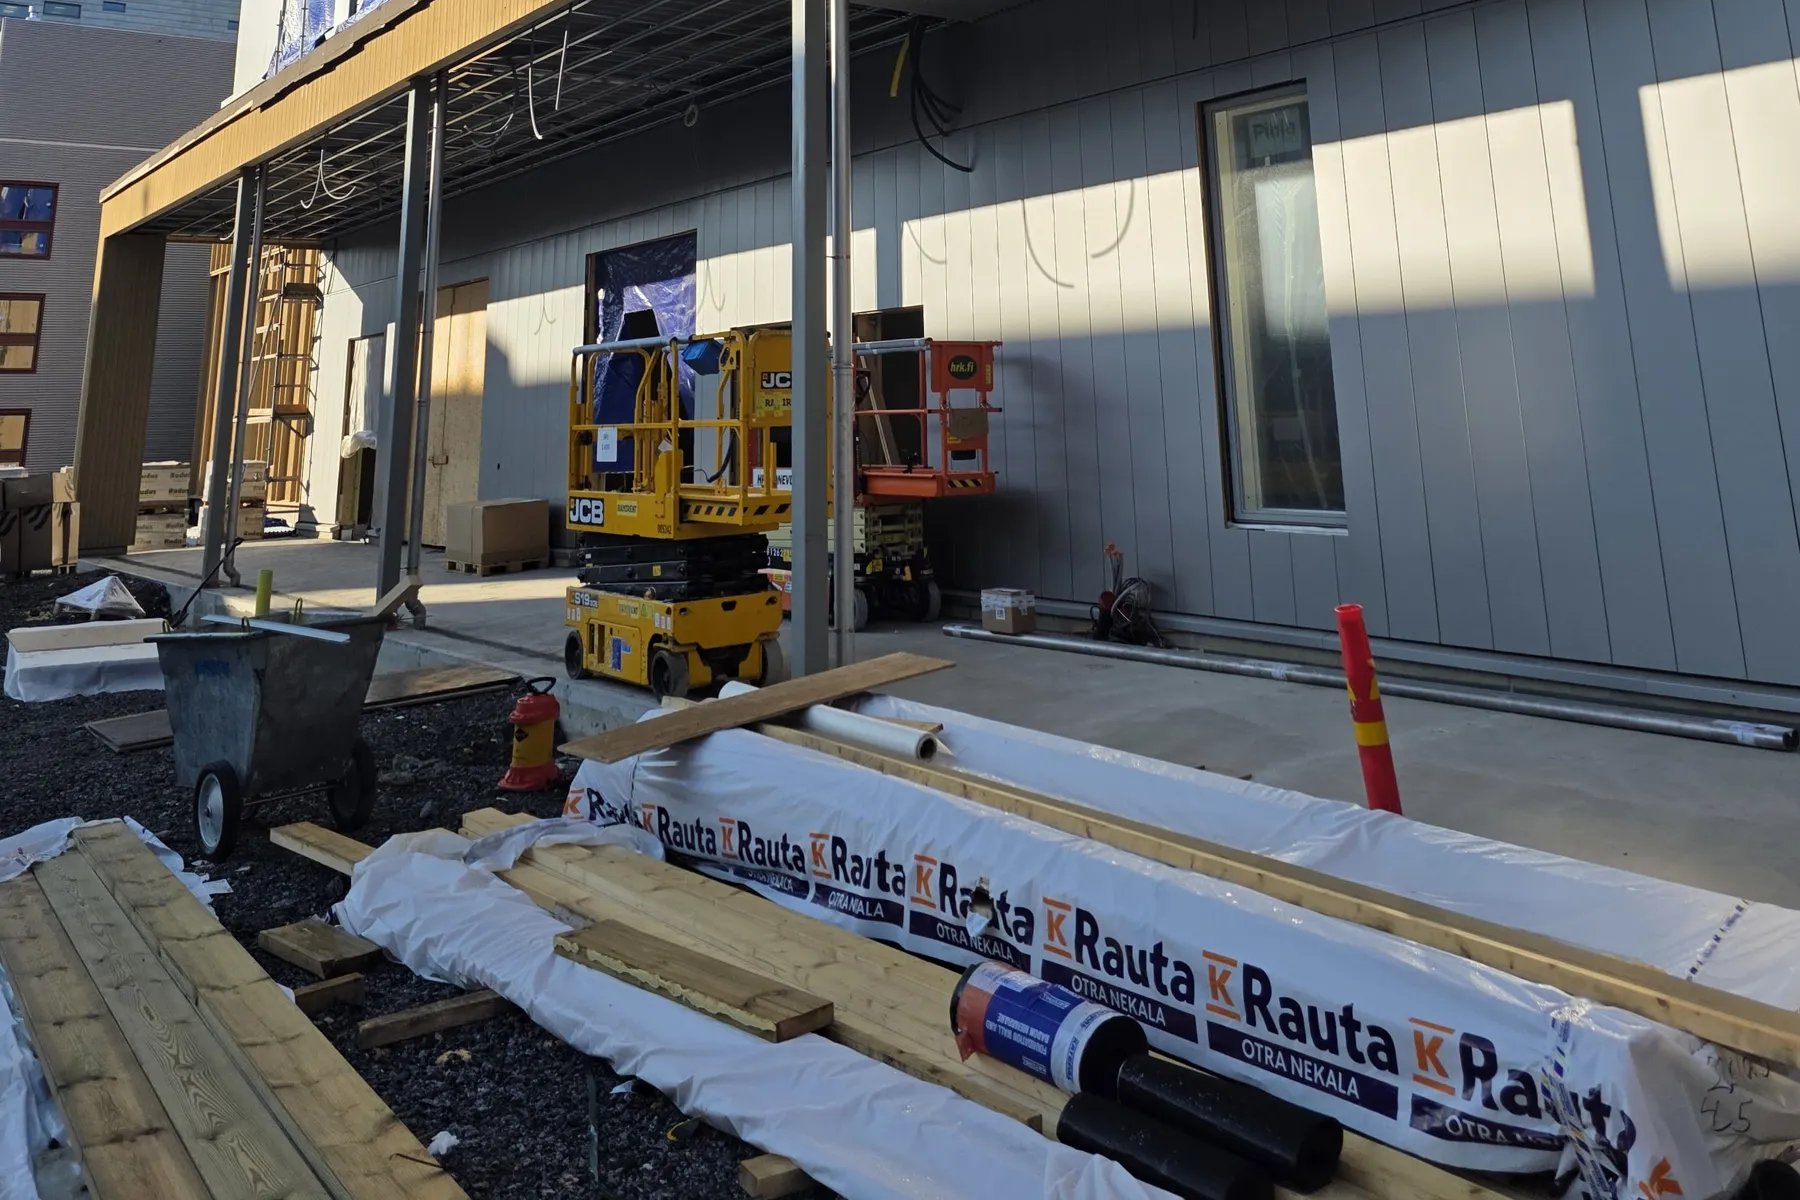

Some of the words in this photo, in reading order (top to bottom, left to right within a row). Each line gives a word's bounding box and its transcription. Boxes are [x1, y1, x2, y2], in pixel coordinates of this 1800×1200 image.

[762, 372, 791, 388] JC
[950, 361, 974, 373] hrk.fi
[569, 498, 604, 524] JCB
[656, 806, 717, 856] Rauta
[737, 820, 806, 875] Rauta
[1074, 907, 1195, 1006] Rauta
[1242, 962, 1399, 1076] Rauta
[936, 921, 969, 946] OTRA
[969, 935, 1015, 963] NEKALA
[1071, 974, 1108, 1004] OTRA
[1109, 989, 1166, 1027] NEKALA
[997, 1024, 1013, 1040] WALL
[1241, 1038, 1287, 1073] OTRA
[1290, 1054, 1360, 1100] NEKALA
[1445, 1114, 1507, 1144] OTRA
